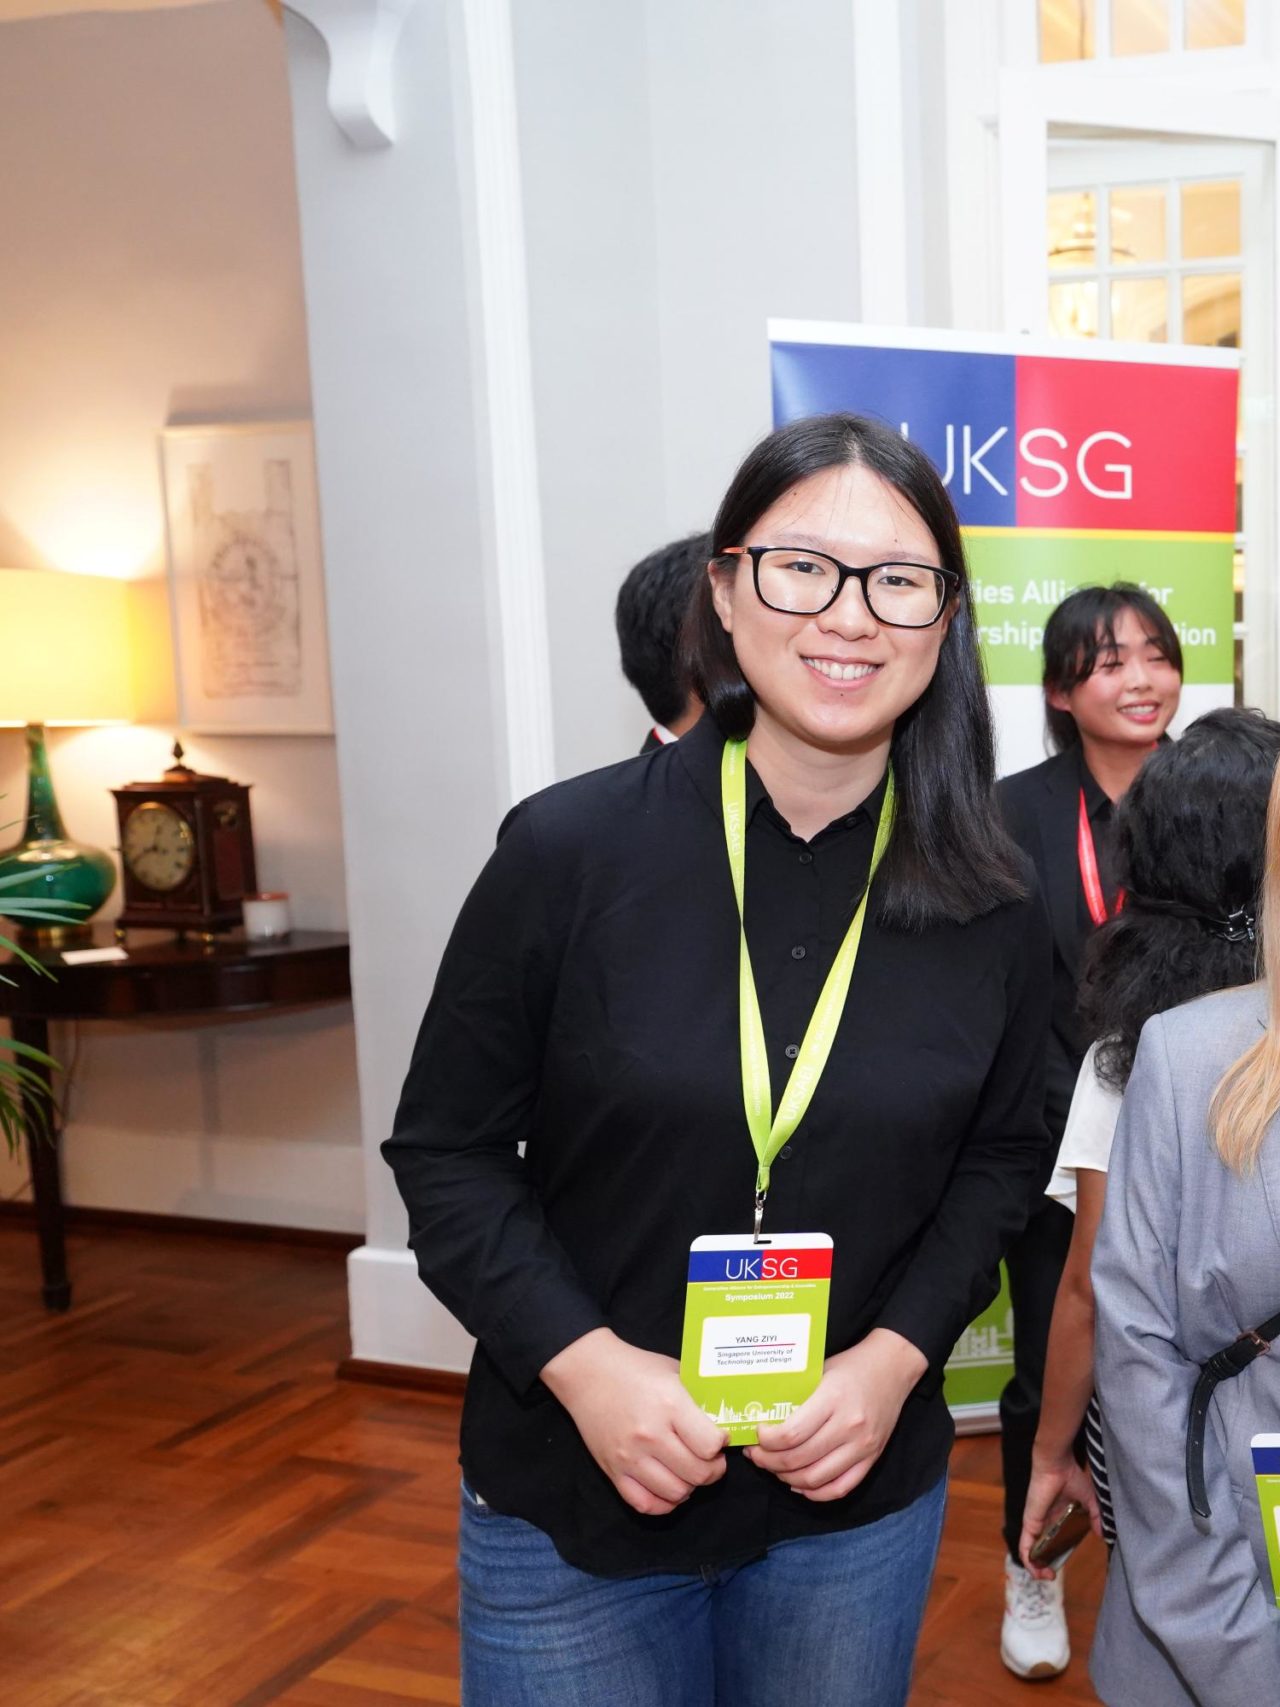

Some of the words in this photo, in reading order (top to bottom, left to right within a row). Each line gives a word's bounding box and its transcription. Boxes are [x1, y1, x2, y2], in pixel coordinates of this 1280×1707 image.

[725, 1257, 799, 1280] UKSG
[725, 1293, 774, 1302] Symposium
[776, 1292, 795, 1300] 2022
[735, 1336, 759, 1344] YANG
[761, 1335, 777, 1343] ZIYI
[752, 1349, 784, 1357] University
